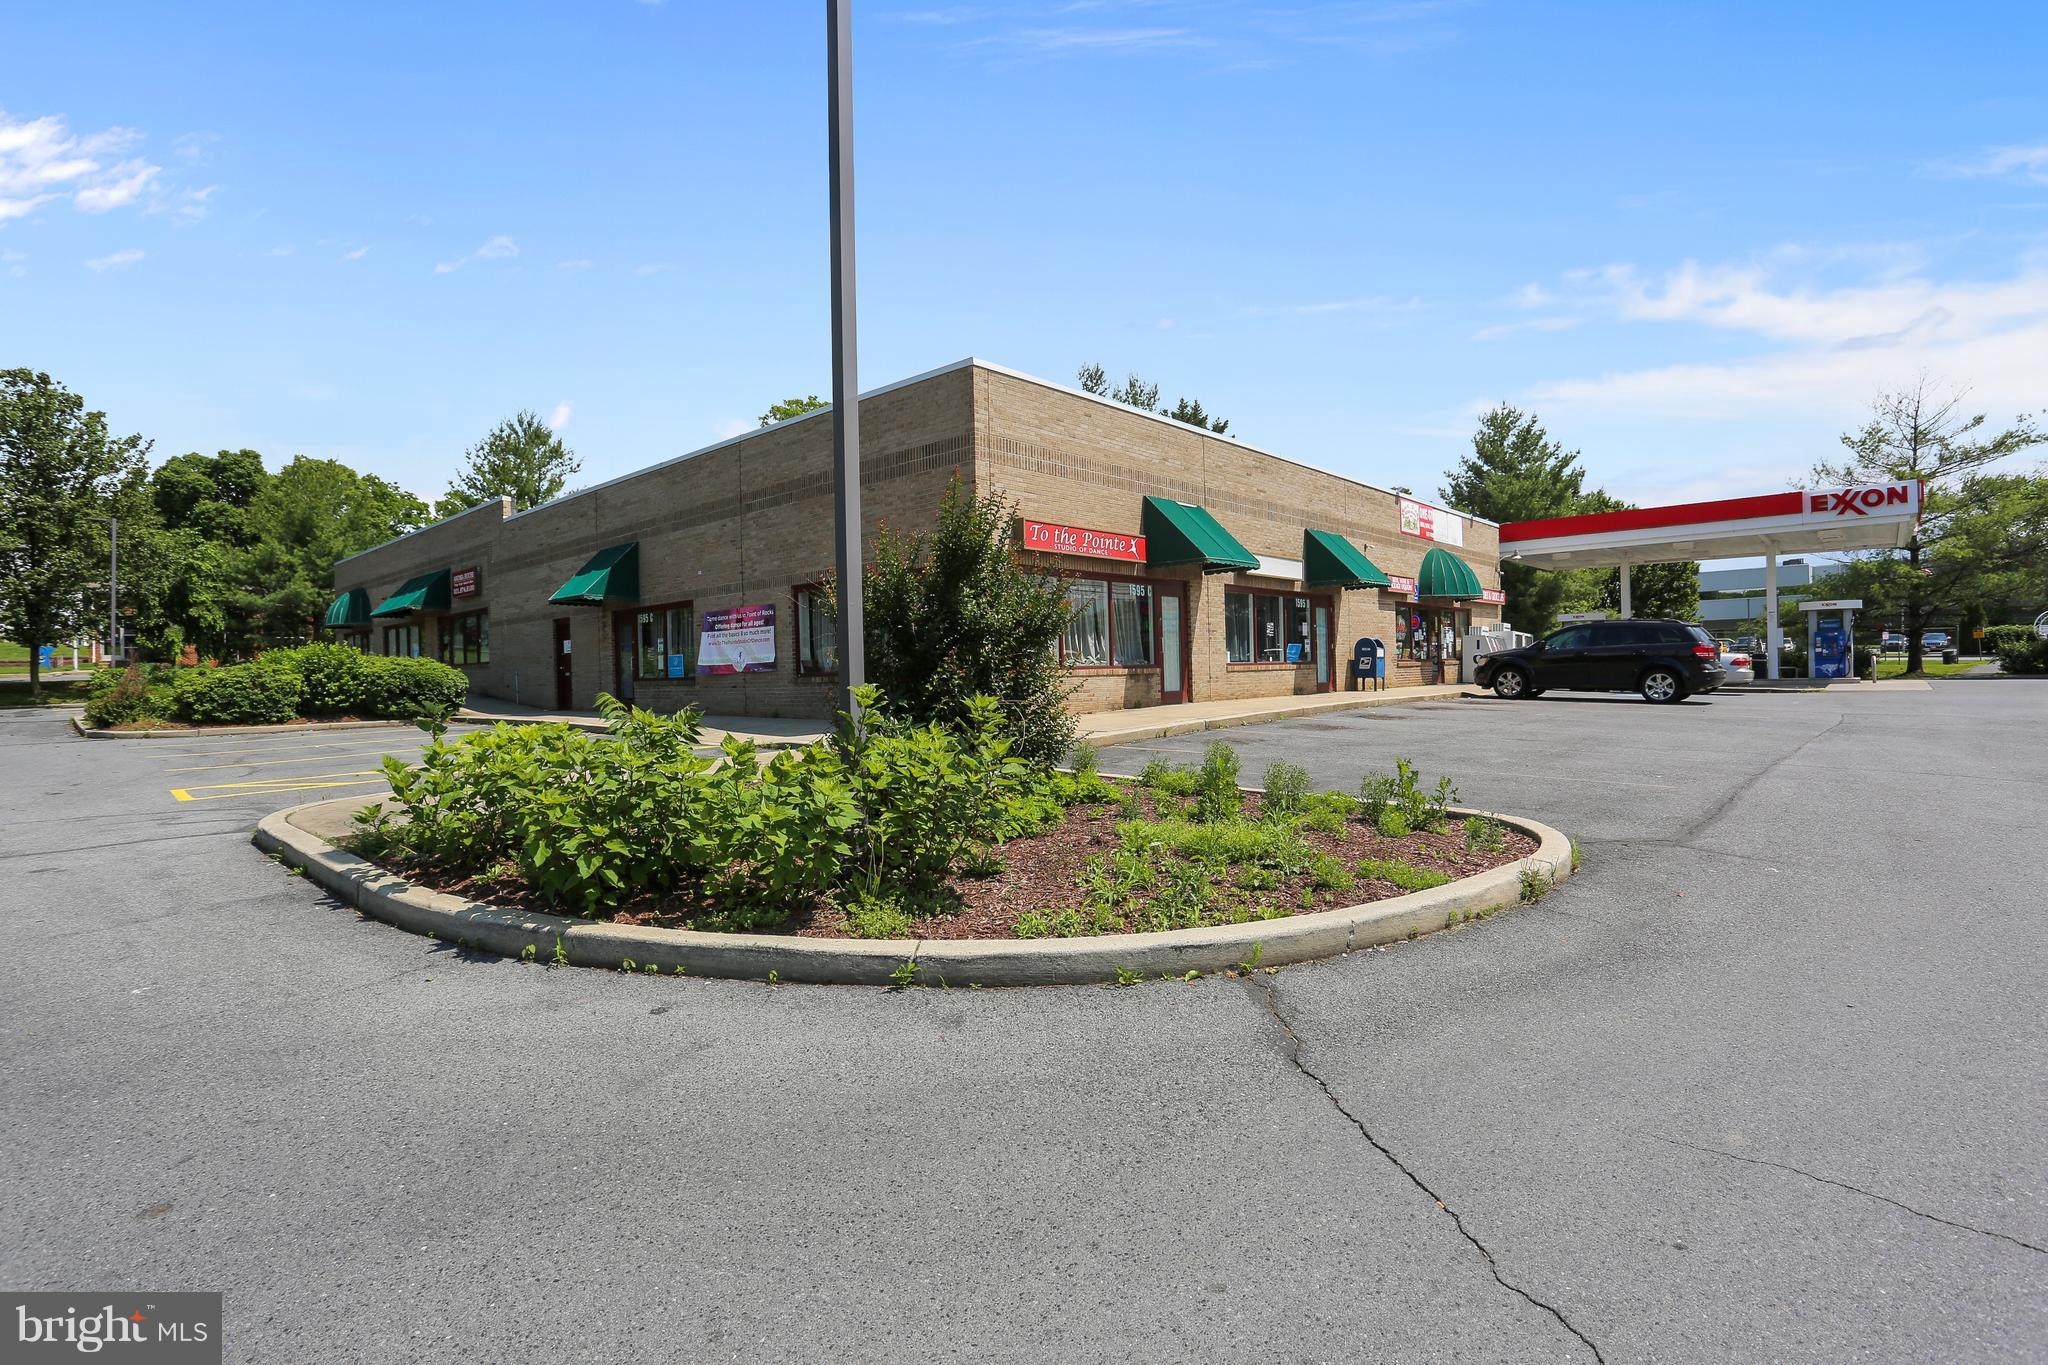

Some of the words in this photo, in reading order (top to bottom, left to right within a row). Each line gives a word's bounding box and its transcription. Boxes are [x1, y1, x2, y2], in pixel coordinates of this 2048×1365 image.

[1811, 485, 1909, 516] EXXON
[1029, 523, 1049, 541] To
[1054, 527, 1077, 545] the
[1082, 532, 1126, 552] Pointe
[1054, 543, 1077, 553] STUDIO
[1079, 546, 1087, 554] OF
[1089, 547, 1109, 556] DANCE
[1129, 584, 1145, 597] 1595
